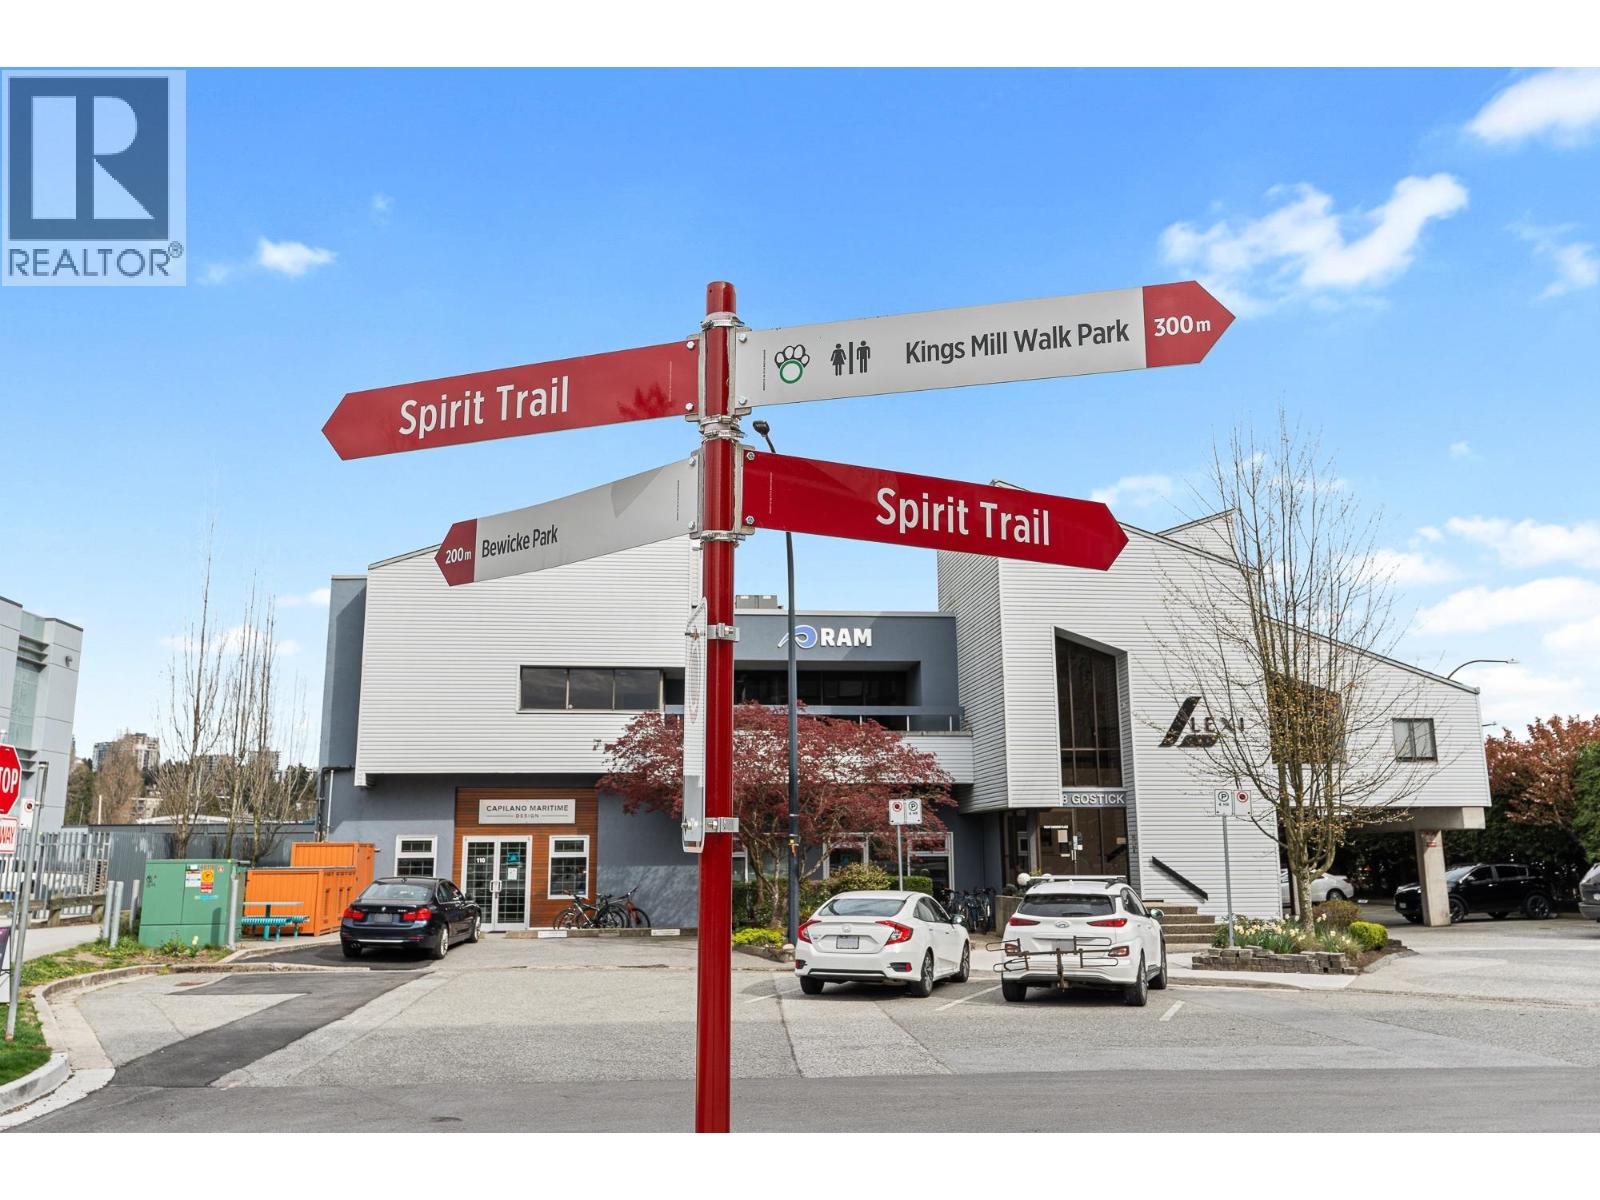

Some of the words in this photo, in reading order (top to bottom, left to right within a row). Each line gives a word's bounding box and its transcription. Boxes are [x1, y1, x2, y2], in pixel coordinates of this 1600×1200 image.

[906, 340, 965, 364] Kings
[971, 331, 1007, 357] Mill
[1014, 325, 1072, 352] Walk
[1078, 319, 1129, 346] Park
[399, 391, 484, 440] Spirit
[496, 376, 569, 421] Trail
[876, 487, 969, 535] Spirit
[979, 501, 1050, 546] Trail
[482, 532, 530, 558] Bewicke
[533, 524, 558, 548] Park
[820, 627, 873, 647] RAM
[1072, 793, 1125, 804] GOSTICK
